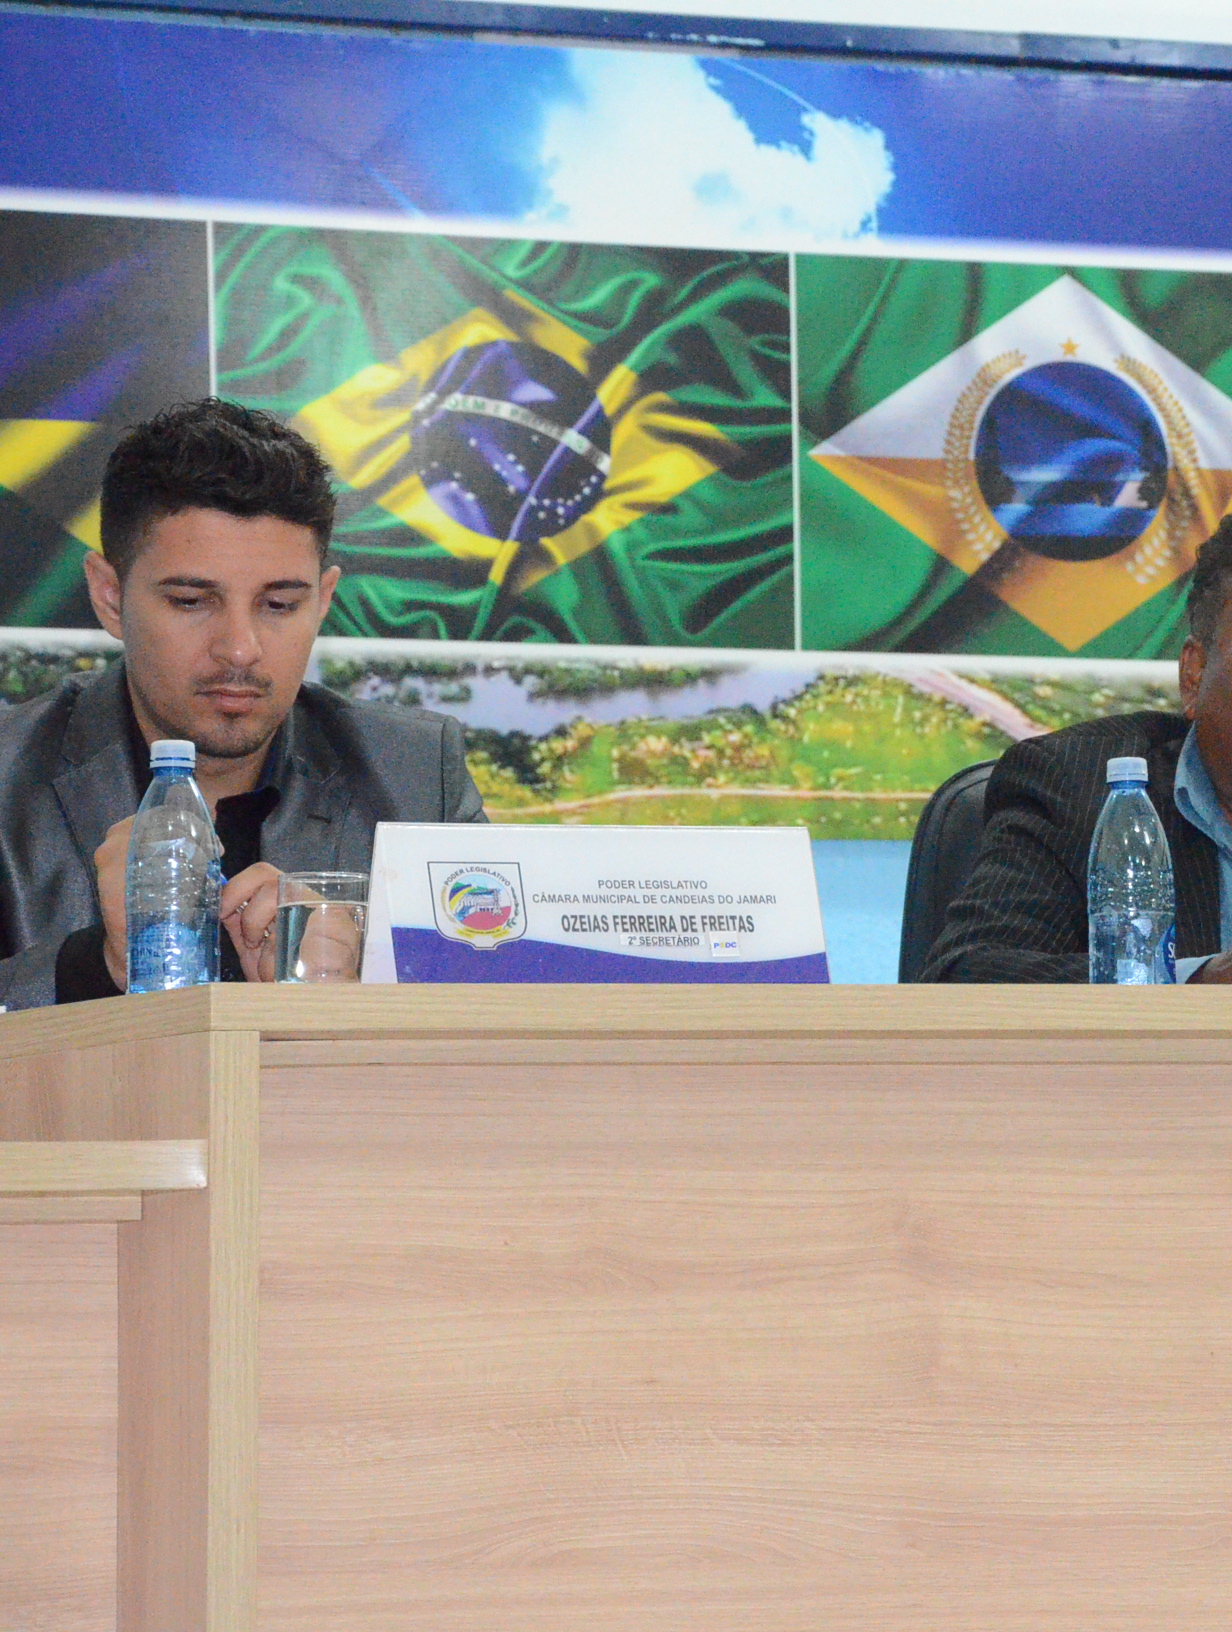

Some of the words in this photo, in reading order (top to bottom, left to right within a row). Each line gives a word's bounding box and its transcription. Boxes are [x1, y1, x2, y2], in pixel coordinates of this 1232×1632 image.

[444, 868, 465, 886] PODER
[465, 866, 511, 887] LEGISLATIVO
[598, 879, 636, 890] PODER
[638, 880, 708, 890] LEGISLATIVO
[532, 893, 579, 904] CÂMARA
[582, 894, 640, 904] MUNICIPAL
[643, 895, 658, 904] DE
[660, 895, 715, 904] CANDEIAS
[718, 895, 733, 905] DO
[736, 895, 777, 905] JAMARI
[561, 914, 609, 933] OZEIAS
[613, 914, 676, 933] FERREIRA
[681, 914, 697, 933] DE
[701, 914, 755, 933] FREITAS
[639, 934, 700, 946] SECRETÁRIO
